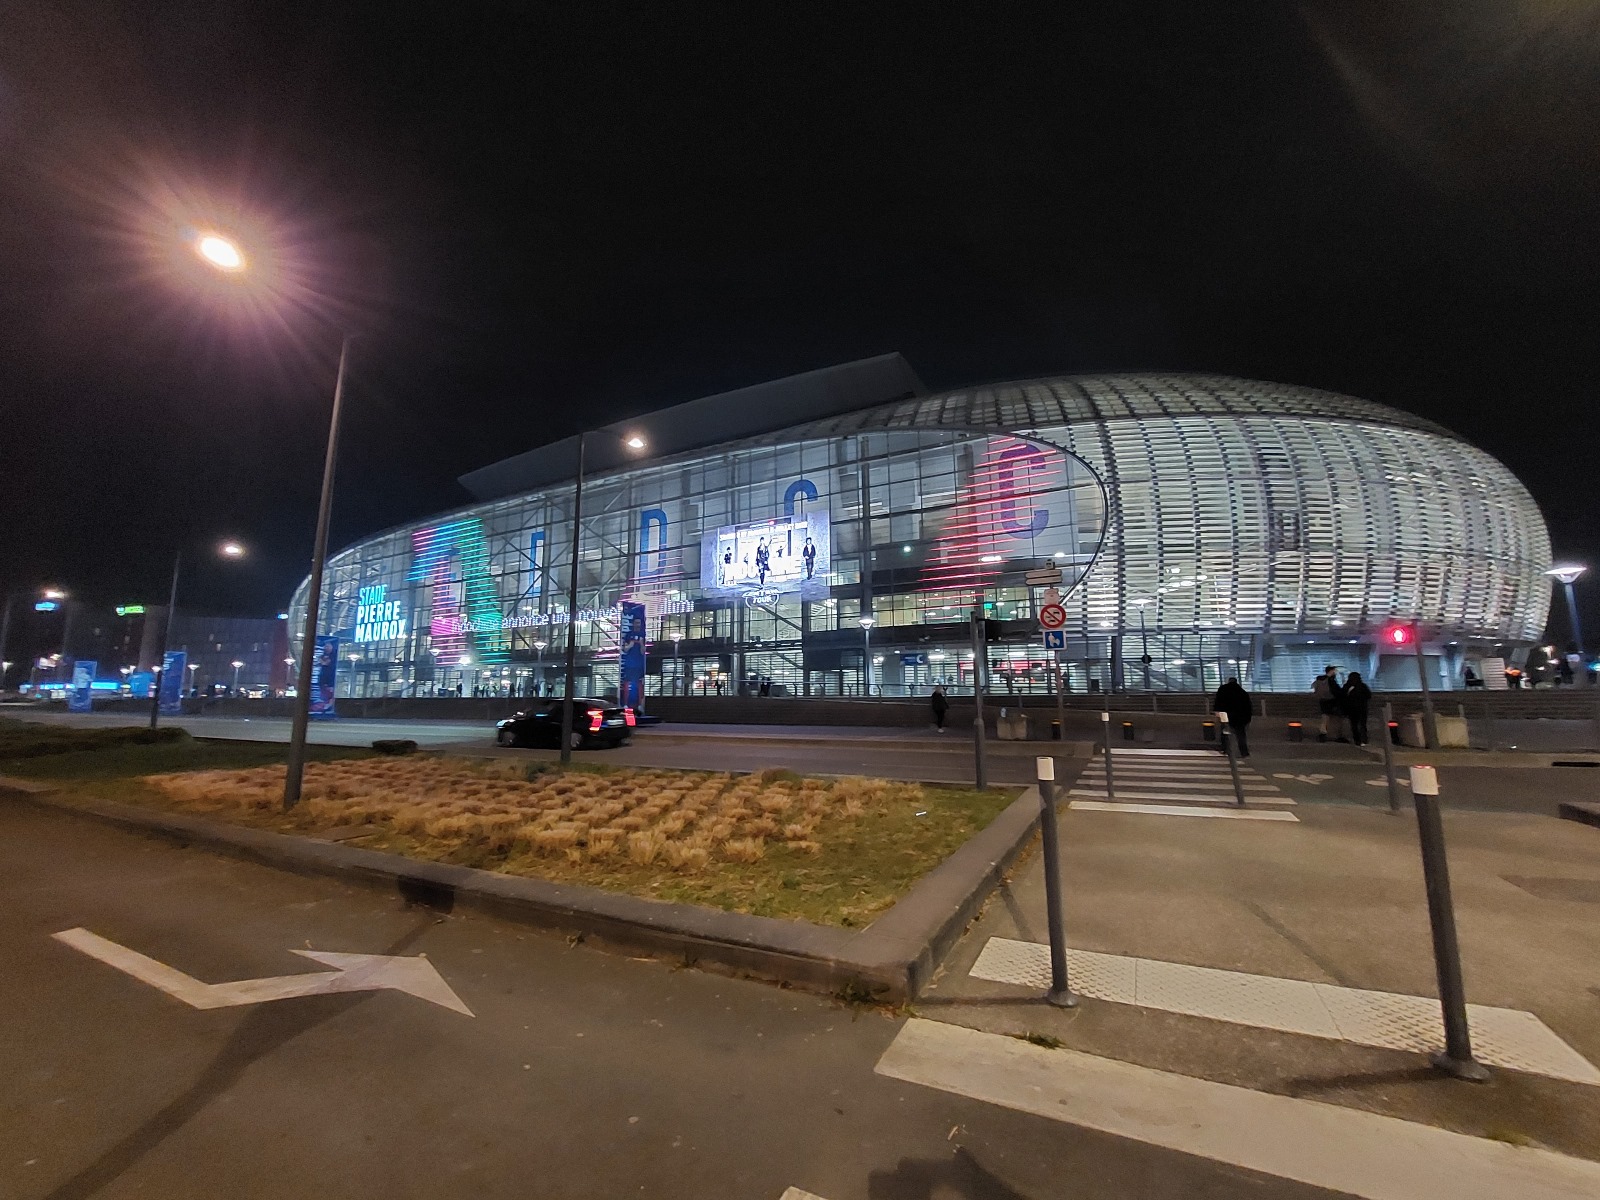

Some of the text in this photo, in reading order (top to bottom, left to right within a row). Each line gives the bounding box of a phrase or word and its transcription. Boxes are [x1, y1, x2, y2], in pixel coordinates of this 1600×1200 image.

[999, 443, 1050, 539] C
[358, 584, 388, 606] STADE
[356, 600, 401, 625] PIERRE
[502, 613, 550, 629] annonce
[354, 619, 407, 642] MAUROY
